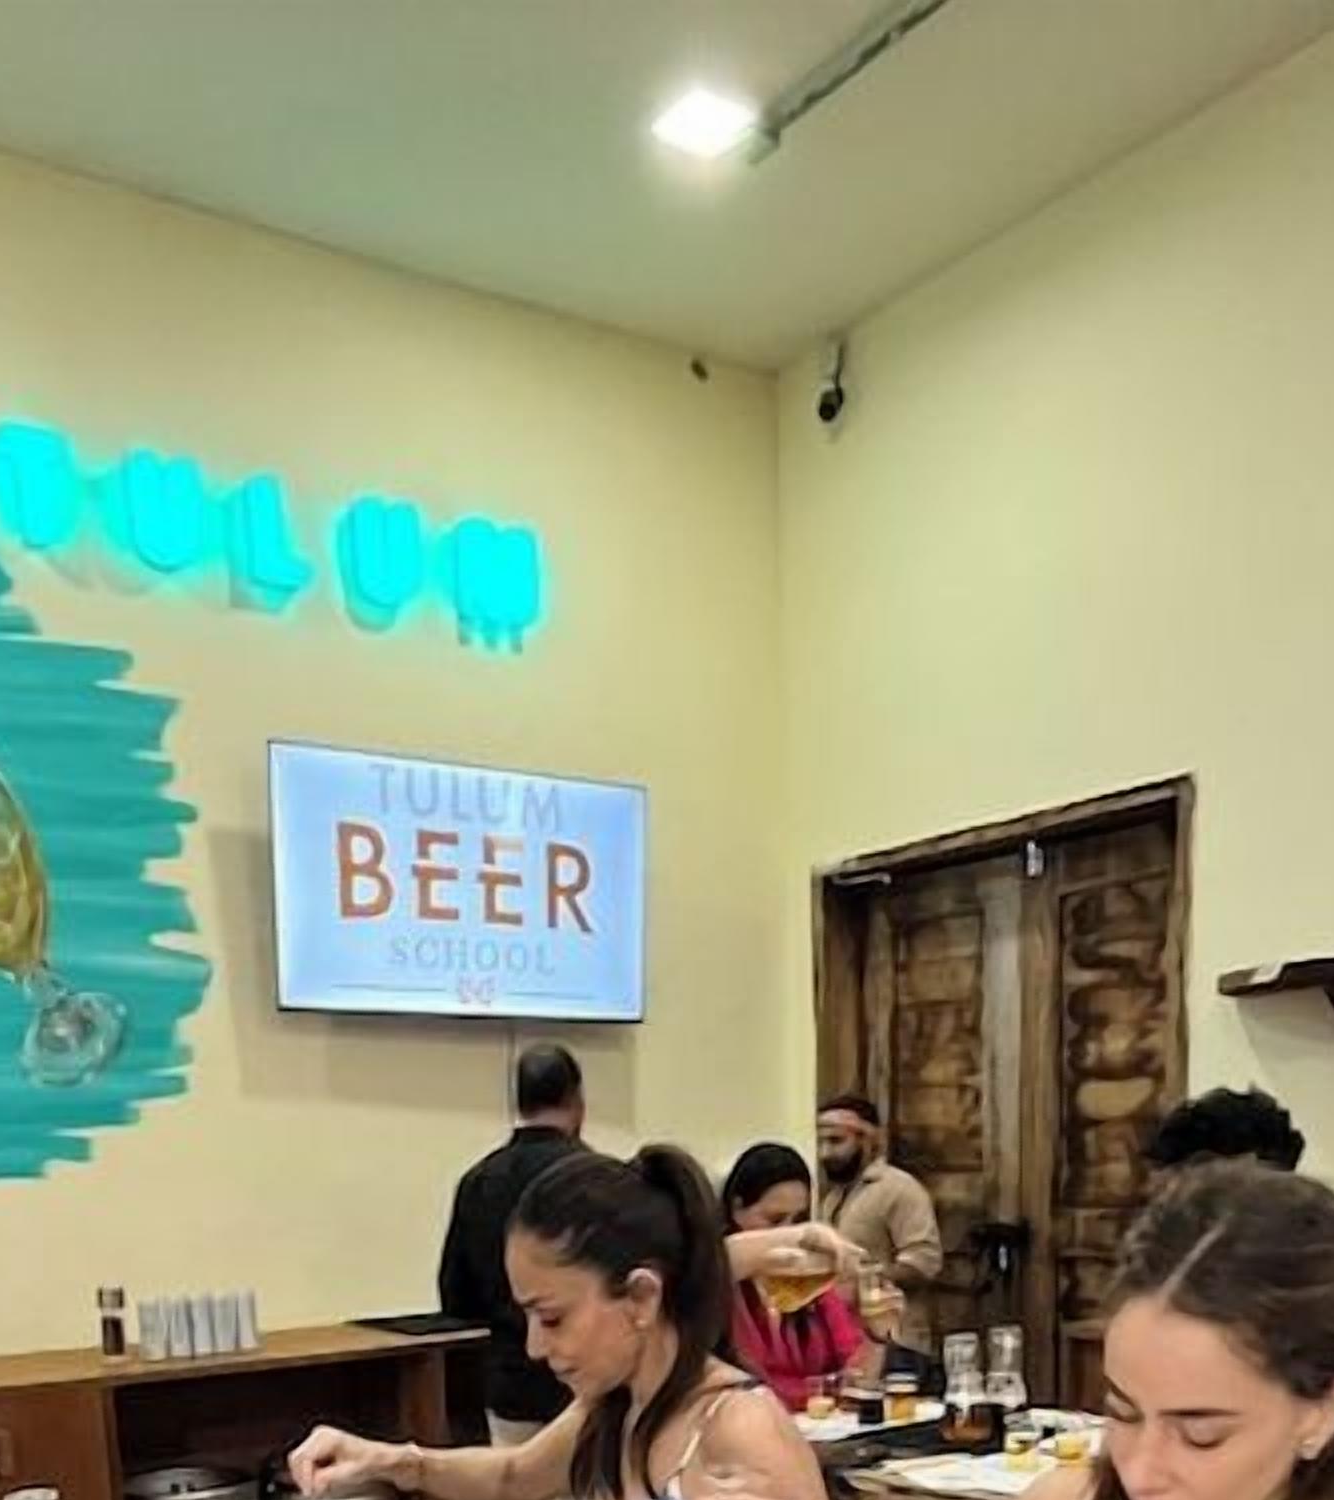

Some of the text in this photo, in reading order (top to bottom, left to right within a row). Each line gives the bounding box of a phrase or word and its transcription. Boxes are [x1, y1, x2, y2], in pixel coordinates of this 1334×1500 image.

[369, 764, 564, 832] TULUM
[335, 820, 594, 934] BEER
[389, 936, 557, 977] SCHOOL
